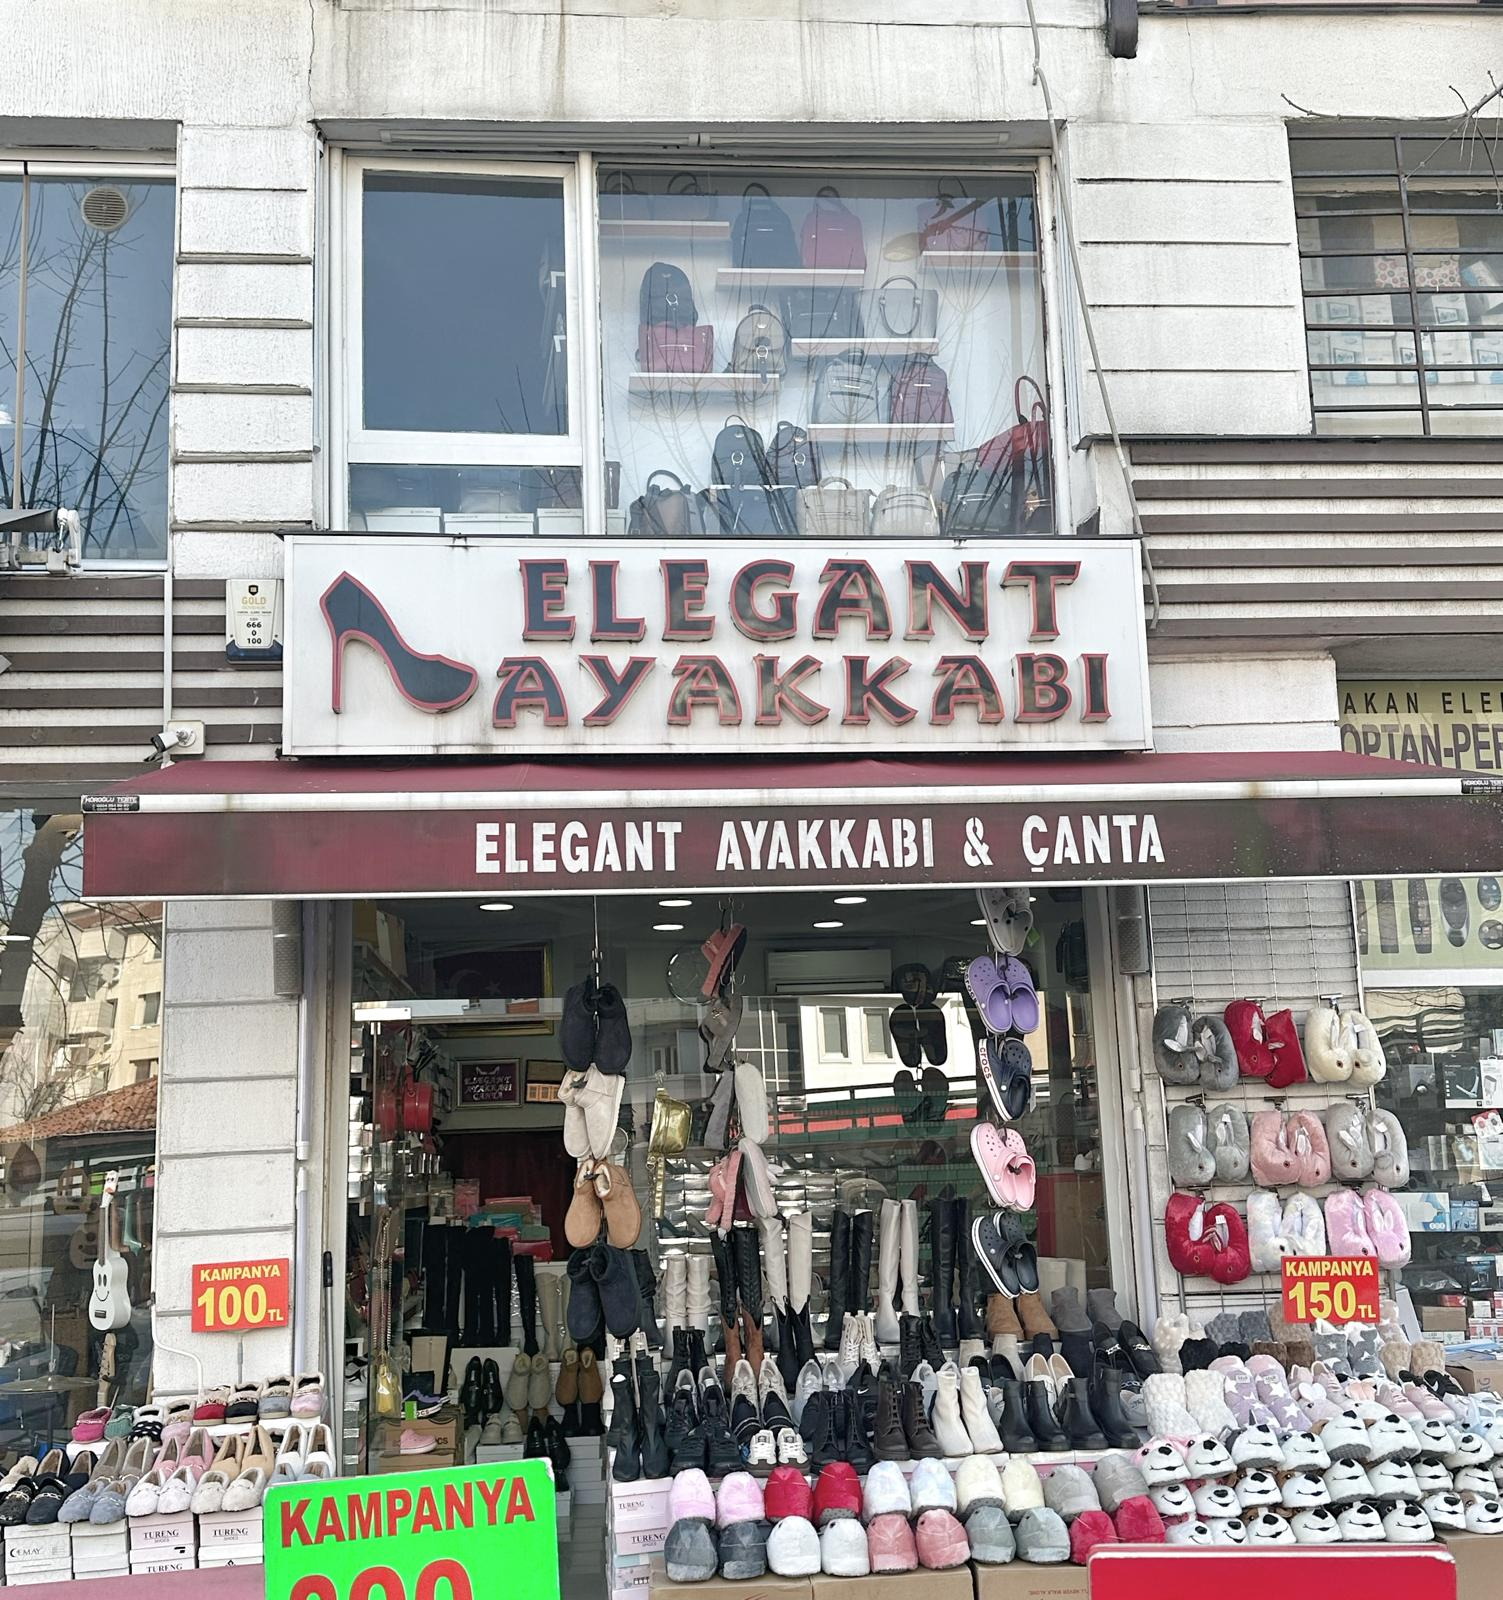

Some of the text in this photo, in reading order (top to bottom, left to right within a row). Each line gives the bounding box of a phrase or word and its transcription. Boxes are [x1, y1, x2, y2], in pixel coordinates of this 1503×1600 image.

[241, 596, 267, 605] GOLD
[518, 559, 1082, 642] ELEGANT
[246, 621, 262, 629] 666
[247, 637, 262, 645] 100
[493, 653, 1112, 727] AYAKKABI
[1344, 692, 1503, 714] AKAN ELE
[475, 814, 1166, 874] ELEGANT AYAKKABI & ÇANTA
[979, 1046, 992, 1080] crocs
[200, 1264, 281, 1282] KAMPANYA
[1285, 1260, 1374, 1277] KAMPANYA
[197, 1284, 284, 1326] 100 TL
[1288, 1281, 1376, 1319] 150 TL
[281, 1476, 536, 1548] KAMPANYA
[143, 1529, 179, 1539] TURENG
[213, 1527, 248, 1537] TURENG
[632, 1533, 666, 1543] TURENG
